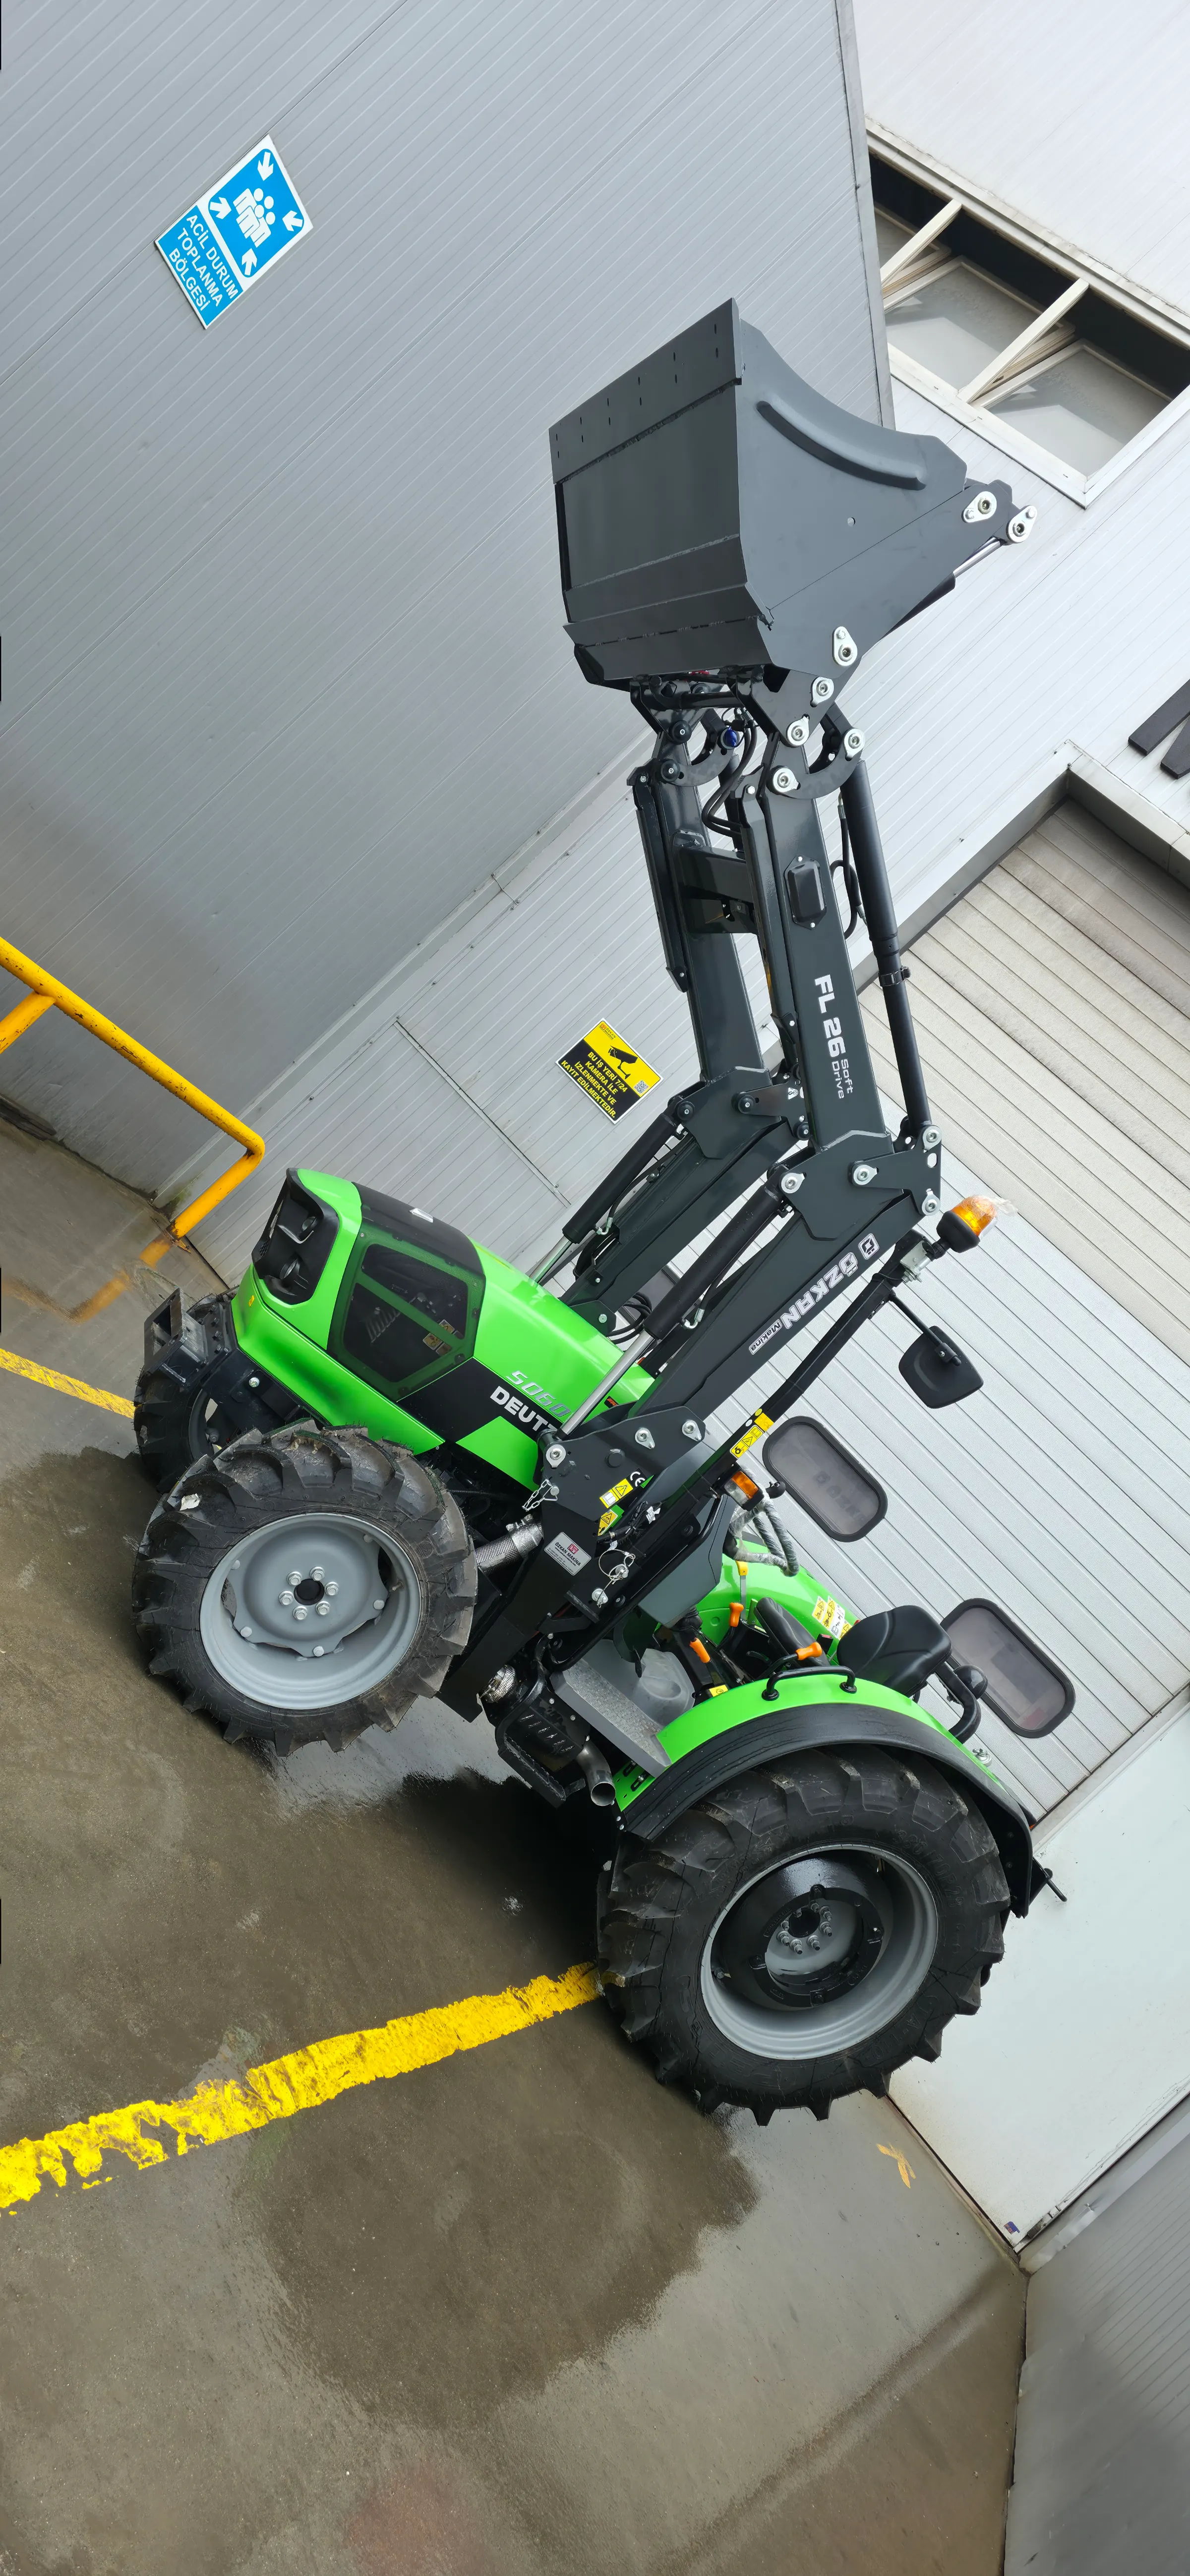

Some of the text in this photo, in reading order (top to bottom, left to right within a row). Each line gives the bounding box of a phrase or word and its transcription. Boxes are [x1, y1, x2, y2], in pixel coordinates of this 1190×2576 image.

[178, 228, 223, 307] TOPLANMA
[186, 214, 238, 299] ACİL DURUM
[169, 248, 211, 311] BÖLGESİ
[814, 974, 846, 1057] FL 26
[561, 1060, 579, 1078] KAYIT
[574, 1061, 617, 1105] İZLENMEKTE VE
[585, 1061, 618, 1094] KAMERA İLE
[588, 1051, 628, 1092] BU İŞ YERİ 7/24
[832, 1060, 844, 1099] Drive
[840, 1059, 853, 1094] Soft
[780, 1252, 858, 1329] ÖZKAN
[751, 1321, 782, 1352] Makina
[505, 1370, 571, 1417] 5060
[555, 1541, 568, 1553] ÖZKAN
[566, 1551, 581, 1566] MAKİNA
